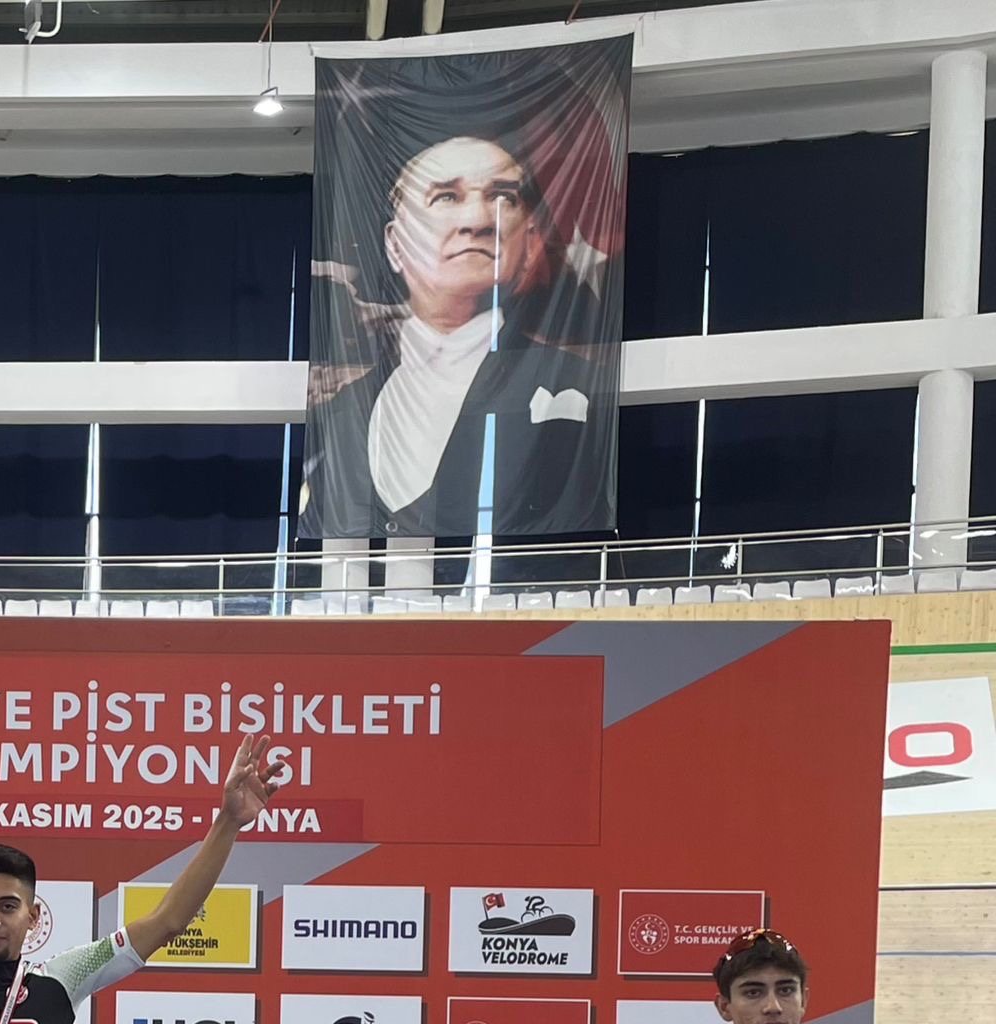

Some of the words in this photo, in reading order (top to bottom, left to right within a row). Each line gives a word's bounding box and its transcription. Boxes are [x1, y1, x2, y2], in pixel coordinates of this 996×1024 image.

[53, 680, 165, 732] PİST
[184, 682, 441, 735] BİSİKLETİ
[102, 804, 183, 831] 2025
[212, 808, 321, 833] NYA
[294, 919, 417, 939] SHIMANO
[695, 925, 738, 935] GENÇLİK
[481, 937, 538, 951] KONYA
[674, 936, 699, 944] SPOR
[482, 952, 568, 965] VELODROME
